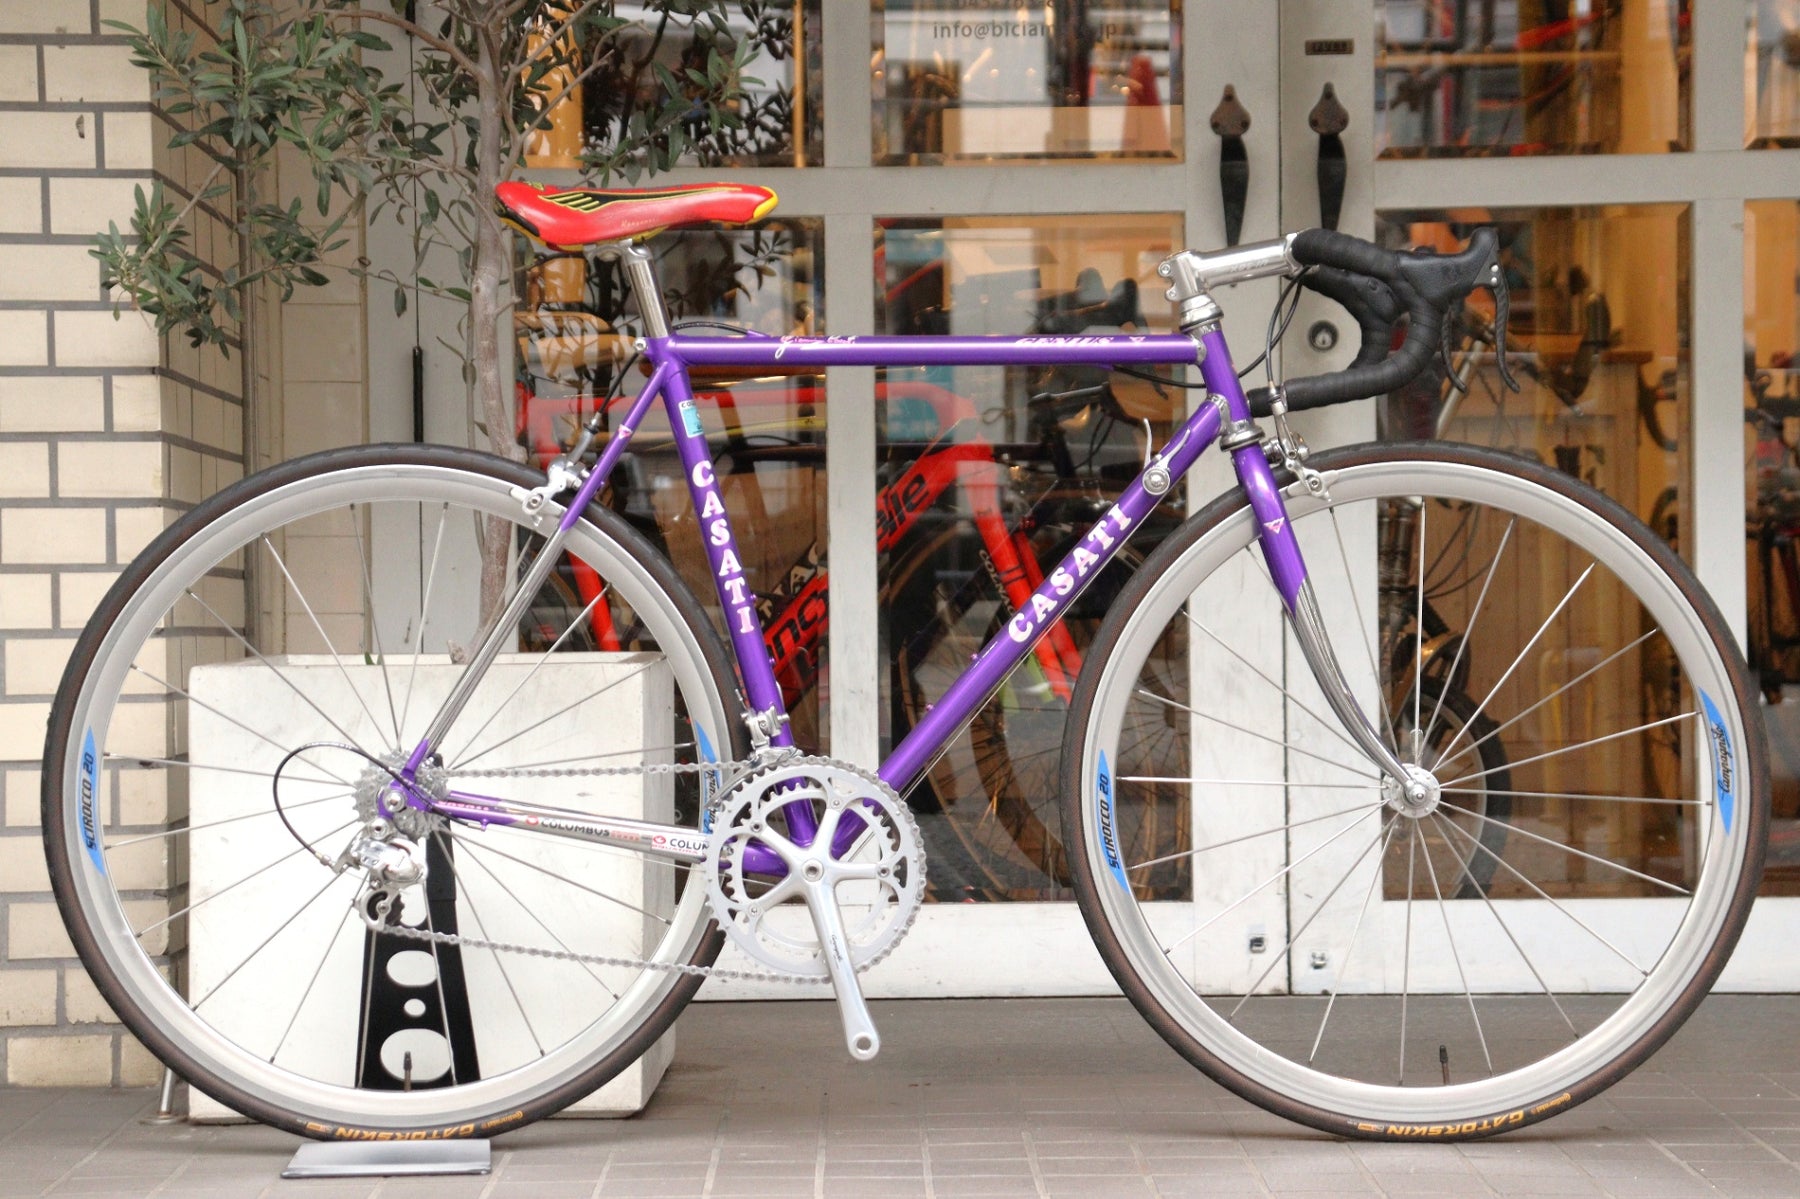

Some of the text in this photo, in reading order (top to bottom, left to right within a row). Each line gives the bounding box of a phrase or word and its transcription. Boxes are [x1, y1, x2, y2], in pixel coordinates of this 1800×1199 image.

[692, 460, 754, 634] CASATI
[1008, 503, 1132, 643] CASATI
[81, 752, 97, 850] SCIROCCO 20
[1711, 723, 1732, 799] Campagnolo
[541, 818, 610, 837] COLUMBUS
[1099, 773, 1120, 870] SCIROCCO 20
[335, 1122, 475, 1141] GATORSKIN
[1386, 1109, 1524, 1136] GATORSKIN
